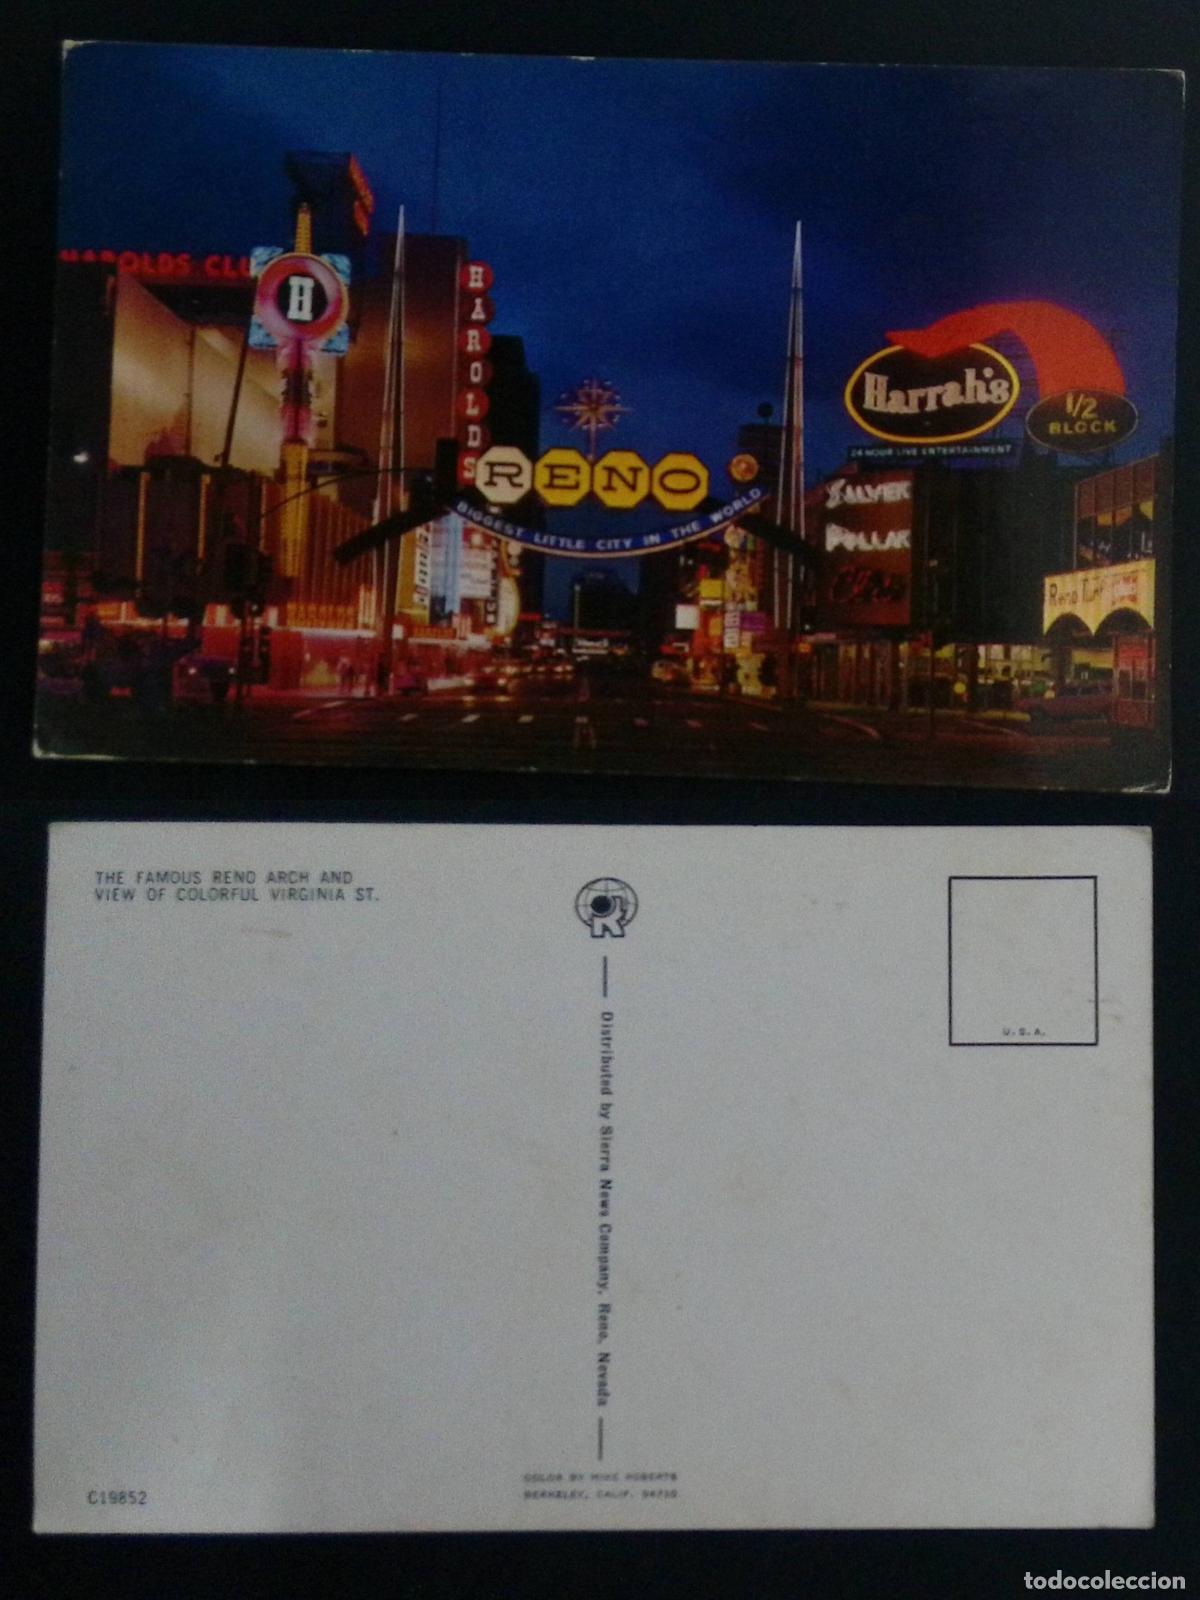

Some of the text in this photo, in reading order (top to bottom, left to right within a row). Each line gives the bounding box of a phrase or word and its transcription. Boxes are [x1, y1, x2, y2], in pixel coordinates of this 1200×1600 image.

[462, 264, 486, 480] HAROLDS
[862, 366, 1010, 415] Harrah's
[1065, 391, 1099, 419] 1/2
[1048, 420, 1116, 435] BLOCK
[483, 461, 701, 494] RENO
[456, 486, 762, 550] BIGGEST LITTLE CITY IN THE WORLD
[94, 870, 354, 885] THE FAMOUS RENO ARCH AND
[94, 887, 381, 902] VIEW OF COLORFUL VIRGINIA ST.
[599, 1011, 614, 1096] Distributed
[597, 1102, 613, 1120] by
[599, 1125, 614, 1172] Sierra
[598, 1178, 613, 1218] News
[596, 1222, 613, 1296] Company,
[595, 1351, 611, 1407] Nevada
[523, 1472, 679, 1482] COLOR BY MIKE ROBERTS
